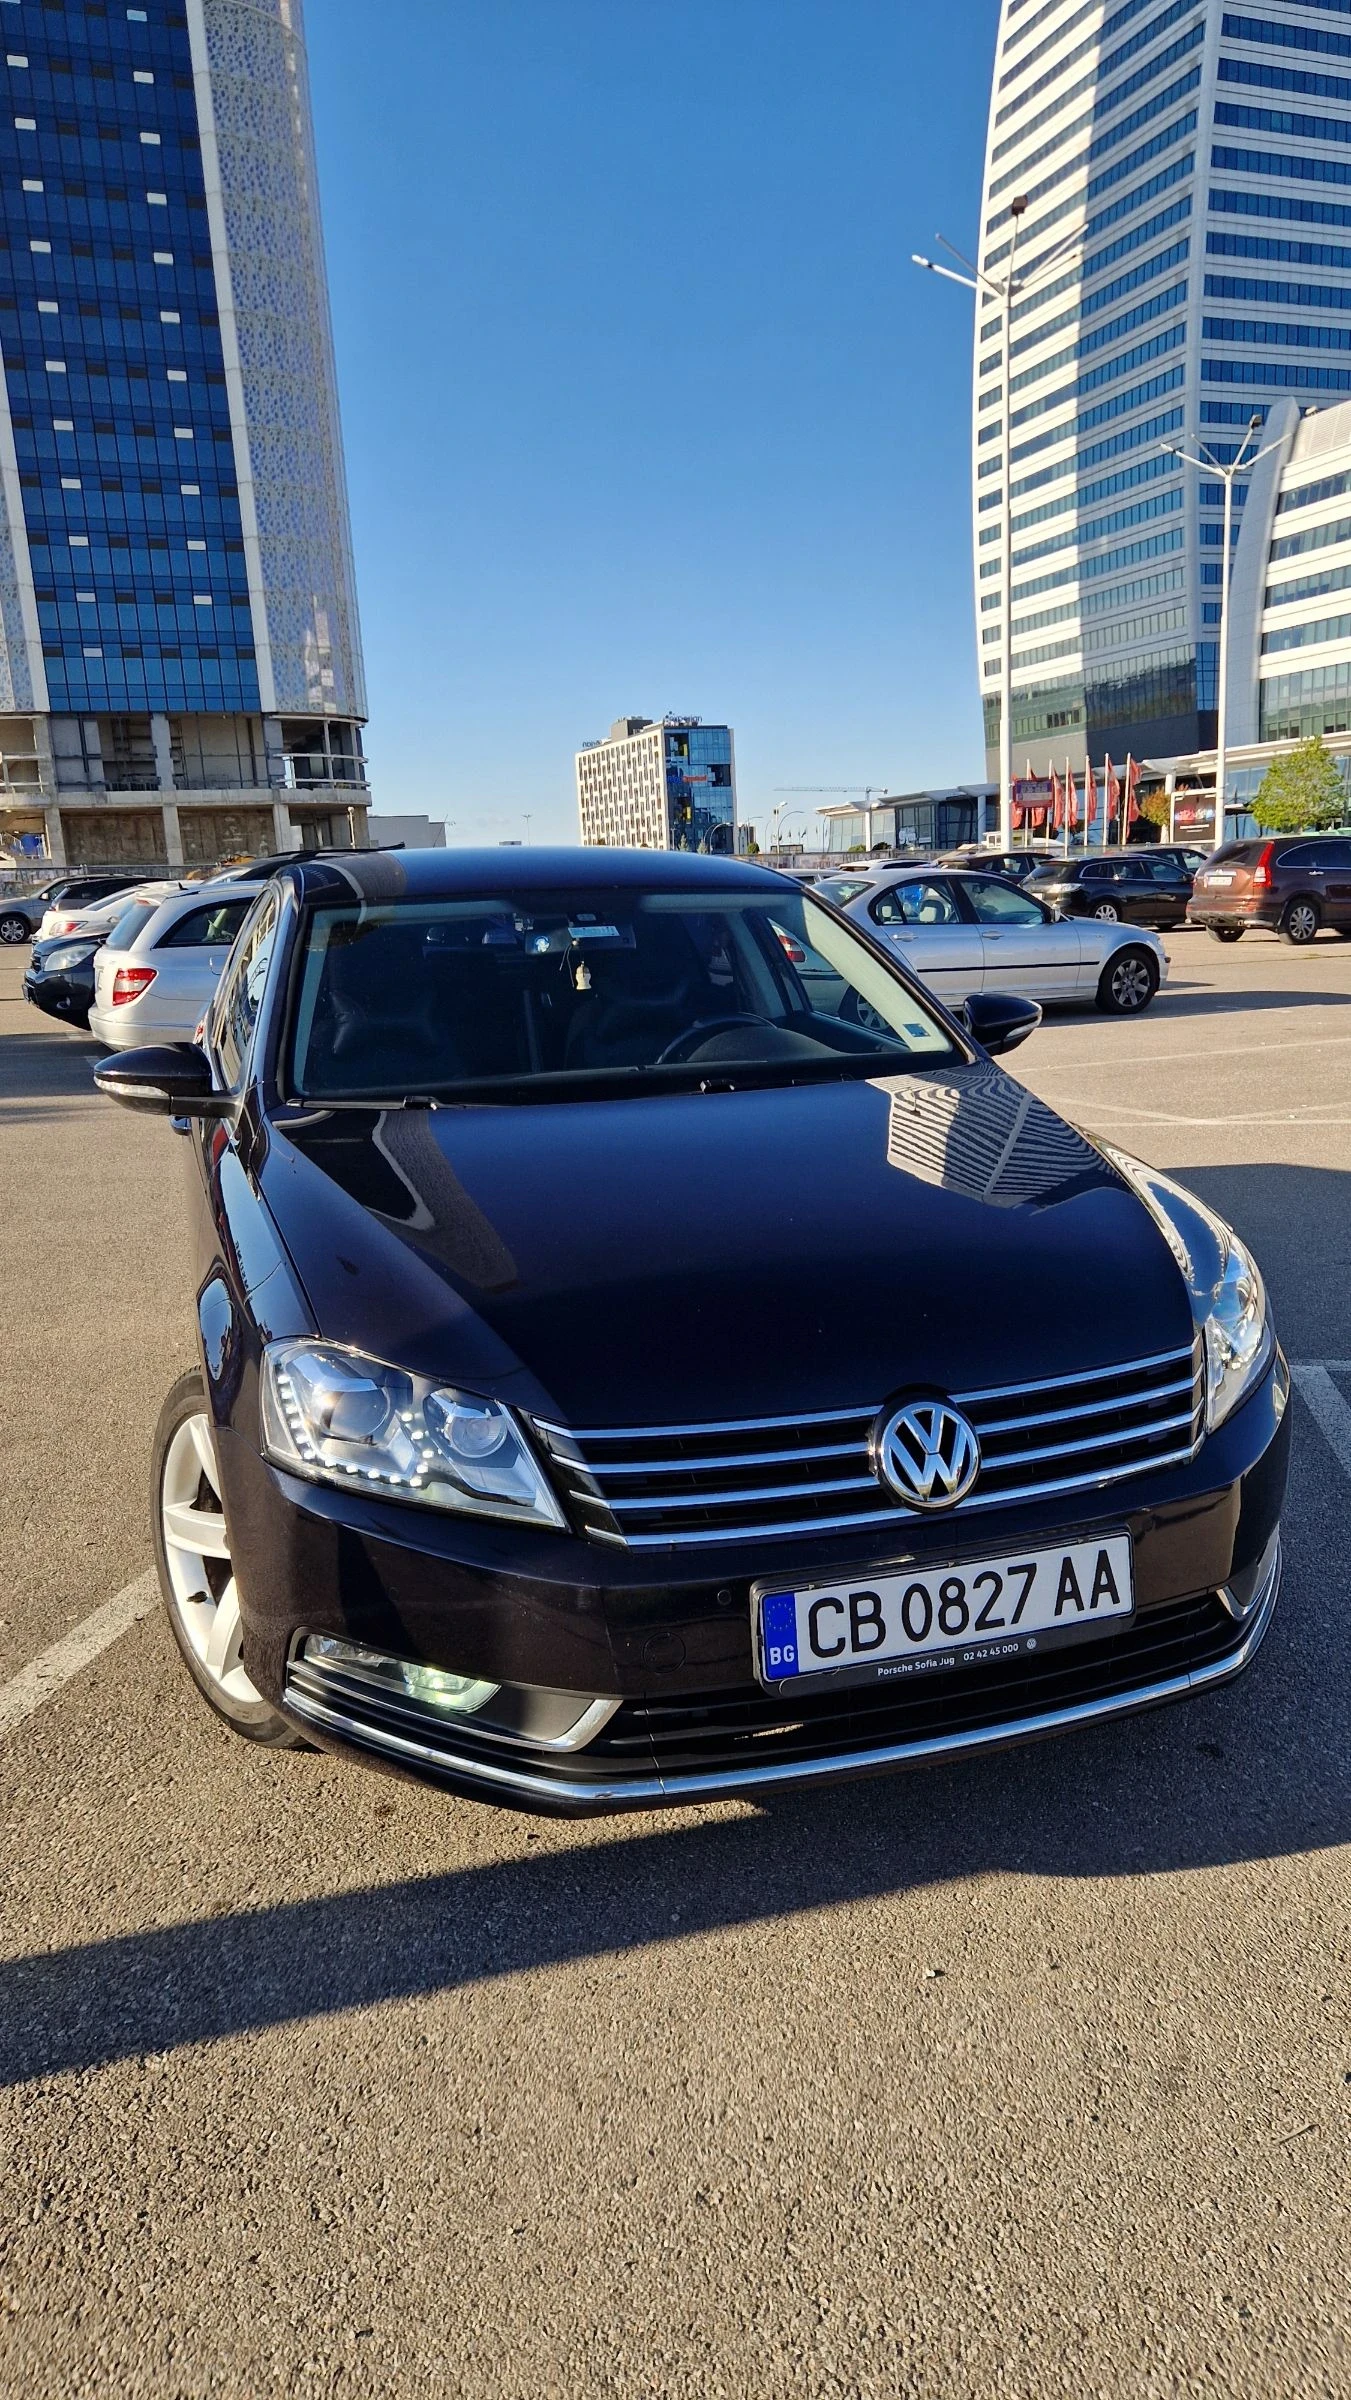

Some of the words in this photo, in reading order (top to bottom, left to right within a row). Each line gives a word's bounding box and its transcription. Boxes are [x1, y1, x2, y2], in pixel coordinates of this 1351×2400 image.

[882, 1401, 979, 1508] VW
[809, 1591, 886, 1658] CB
[901, 1563, 1037, 1643] 0827
[1054, 1550, 1121, 1616] AA
[769, 1645, 795, 1665] BG
[877, 1663, 913, 1676] Porsche
[915, 1659, 938, 1670] Sofia
[939, 1657, 955, 1666] Jug
[963, 1652, 975, 1661] 02
[976, 1649, 988, 1659] 42
[989, 1646, 1000, 1656] 45
[1002, 1643, 1019, 1654] 000
